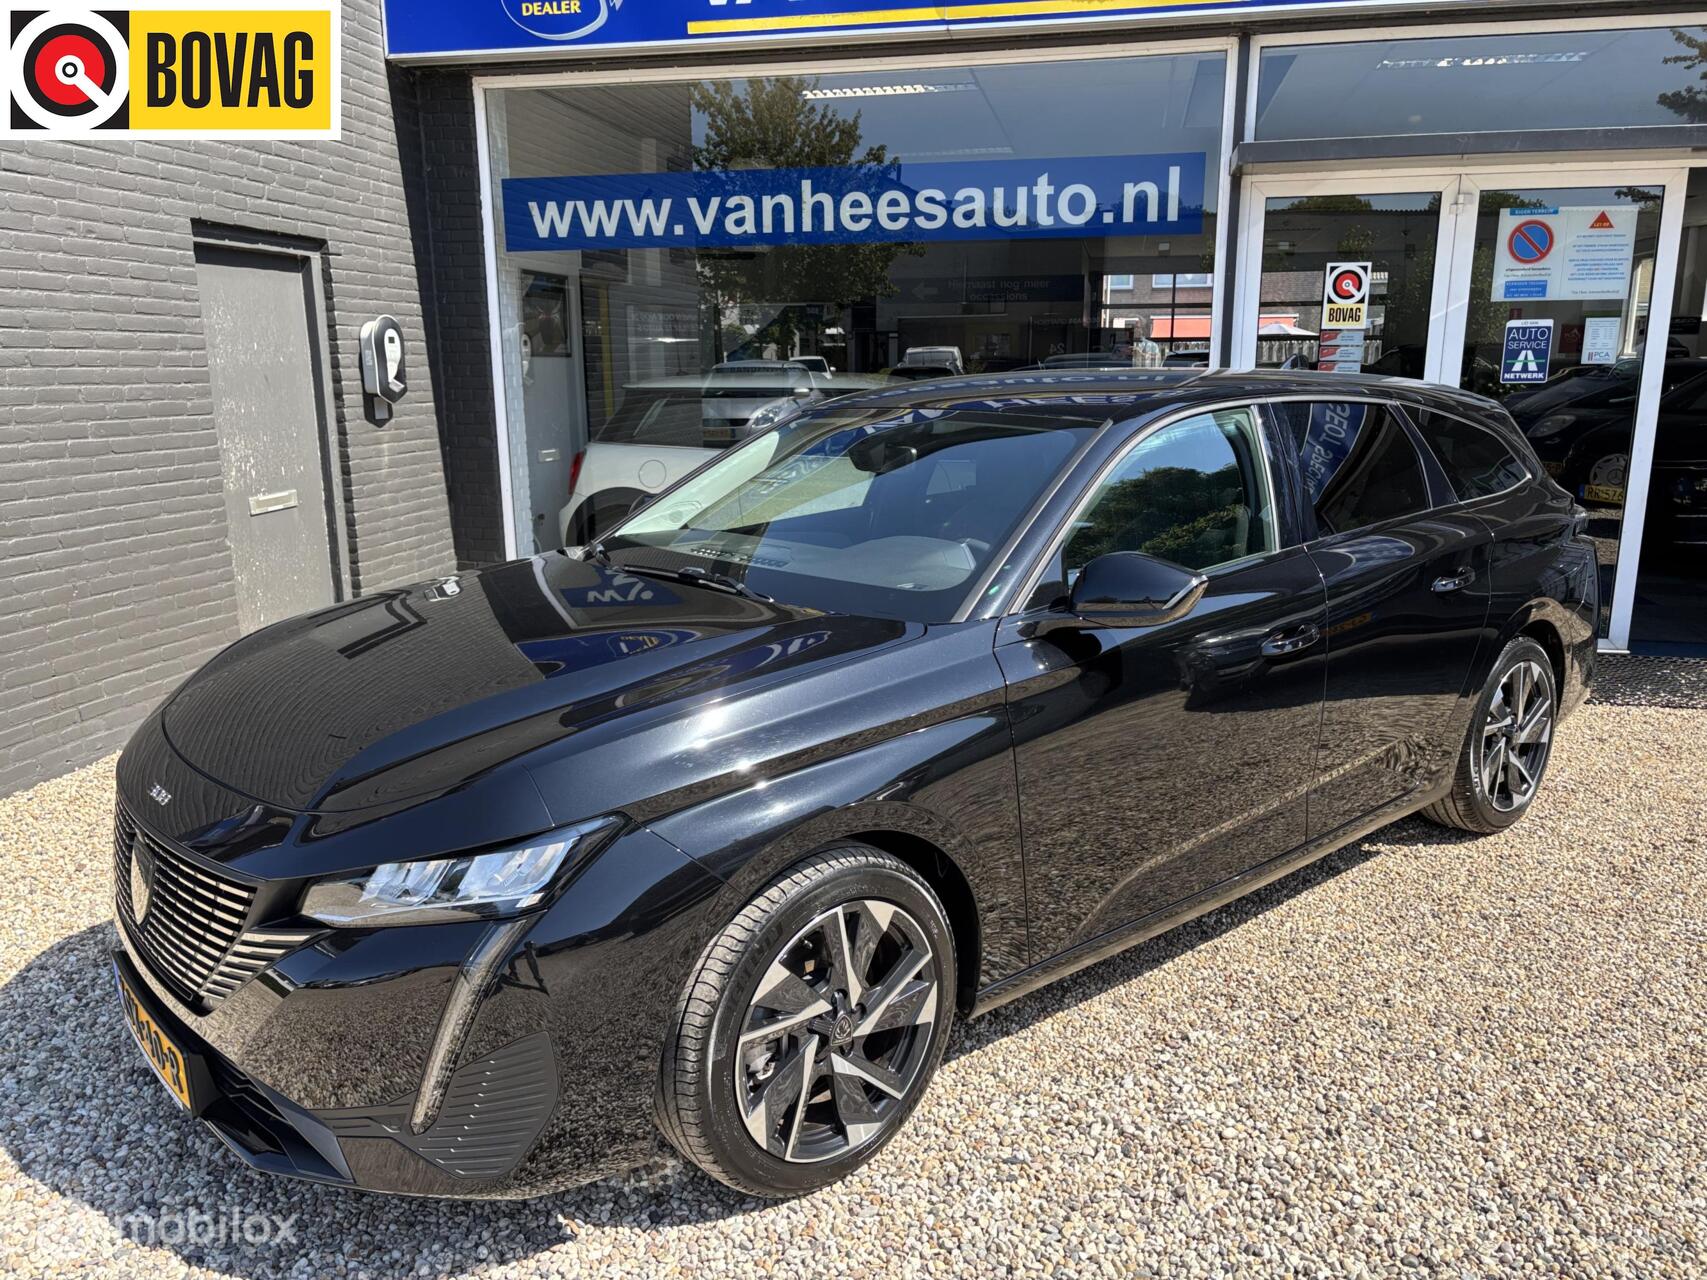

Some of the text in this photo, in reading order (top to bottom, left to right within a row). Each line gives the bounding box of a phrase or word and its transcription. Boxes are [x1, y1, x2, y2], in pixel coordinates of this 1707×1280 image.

[522, 0, 581, 16] DEALER
[528, 166, 1180, 238] www.vanheesauto.nl
[1328, 307, 1361, 323] BOVAG
[1508, 328, 1548, 340] AUTO
[1507, 340, 1547, 349] SERVICE
